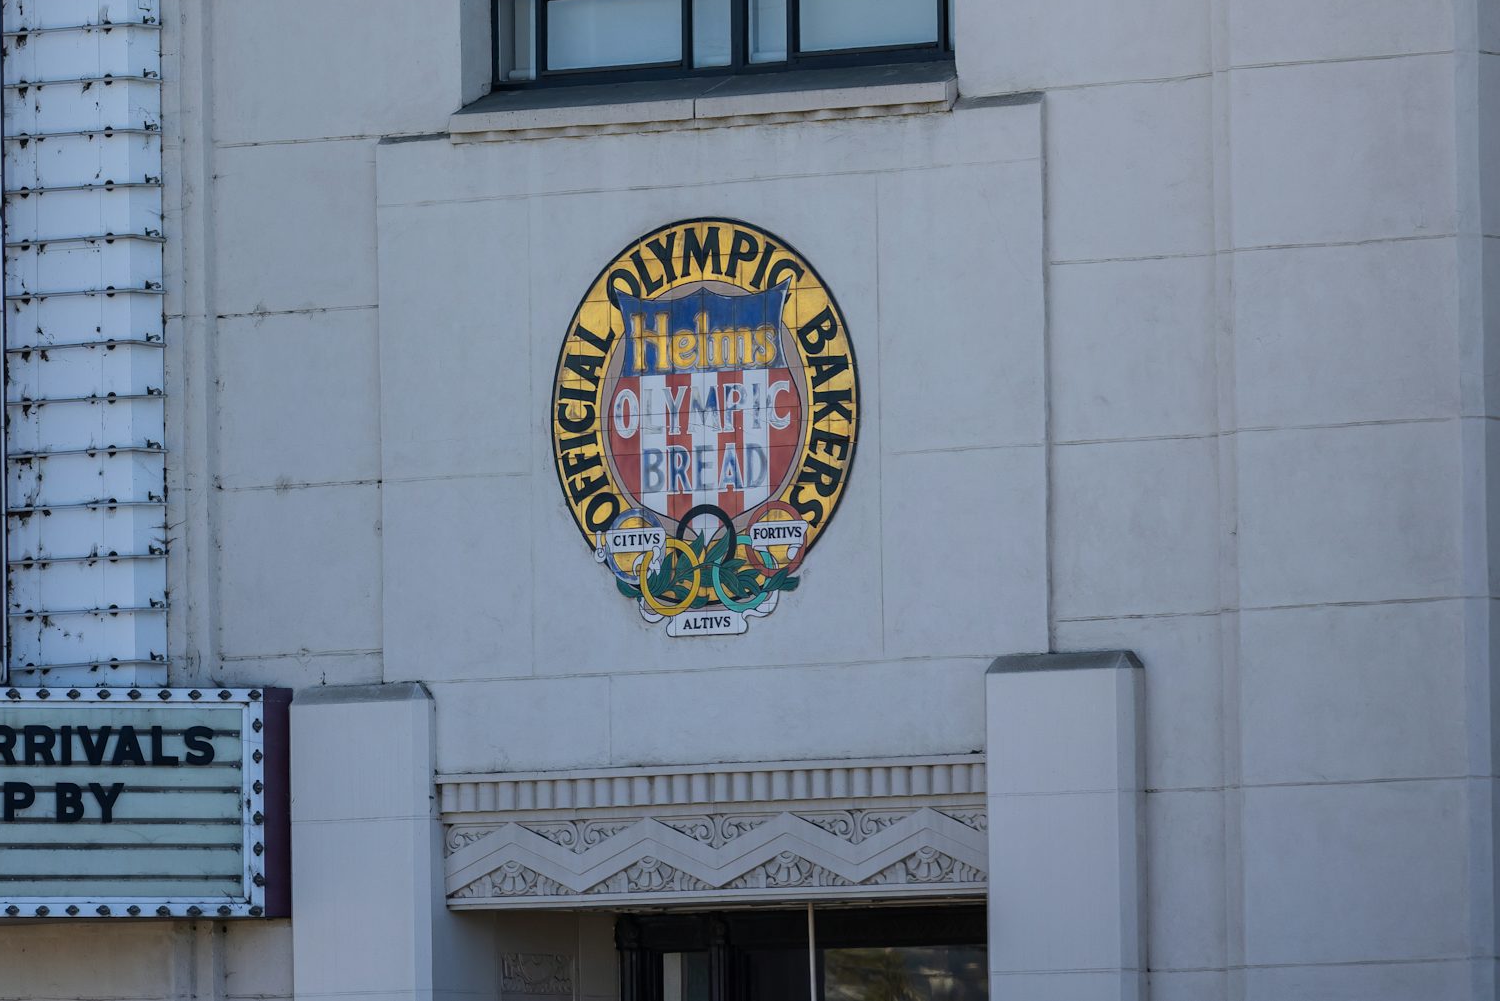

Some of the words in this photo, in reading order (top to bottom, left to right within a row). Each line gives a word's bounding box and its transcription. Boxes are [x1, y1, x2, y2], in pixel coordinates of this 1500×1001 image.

[630, 311, 778, 373] Helms
[558, 324, 621, 533] OFFICIAL
[606, 226, 805, 311] OLYMPIC
[790, 305, 853, 529] BAKERS
[613, 380, 792, 439] OLYMPIC
[643, 443, 769, 495] BREAD
[613, 533, 661, 547] CITIVS
[753, 526, 802, 540] FORTIVS
[683, 616, 732, 630] ALTIVS
[56, 782, 125, 823] BY
